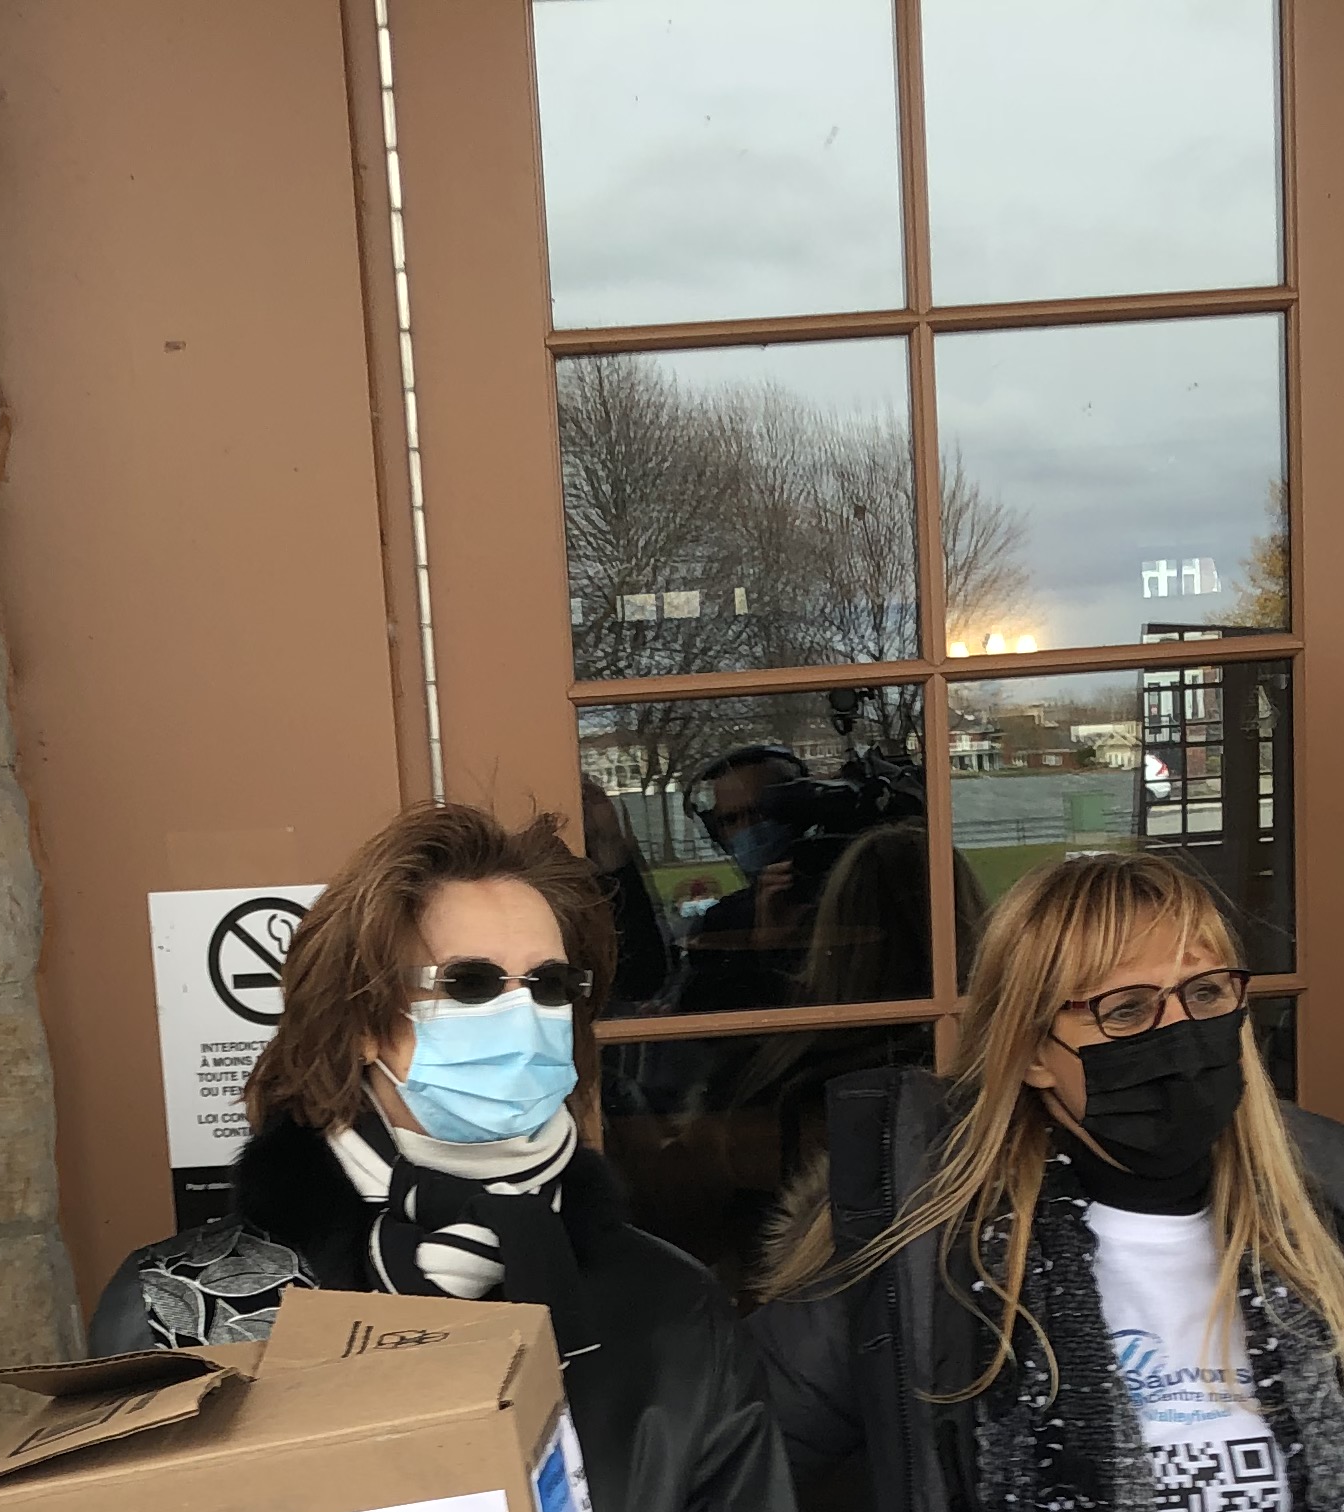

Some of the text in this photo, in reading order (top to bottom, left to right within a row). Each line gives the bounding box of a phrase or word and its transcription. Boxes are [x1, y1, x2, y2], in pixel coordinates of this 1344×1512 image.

[200, 1055, 253, 1068] À MOINS
[196, 1071, 238, 1083] TOUTE
[199, 1086, 219, 1098] OU
[197, 1113, 218, 1125] LOI
